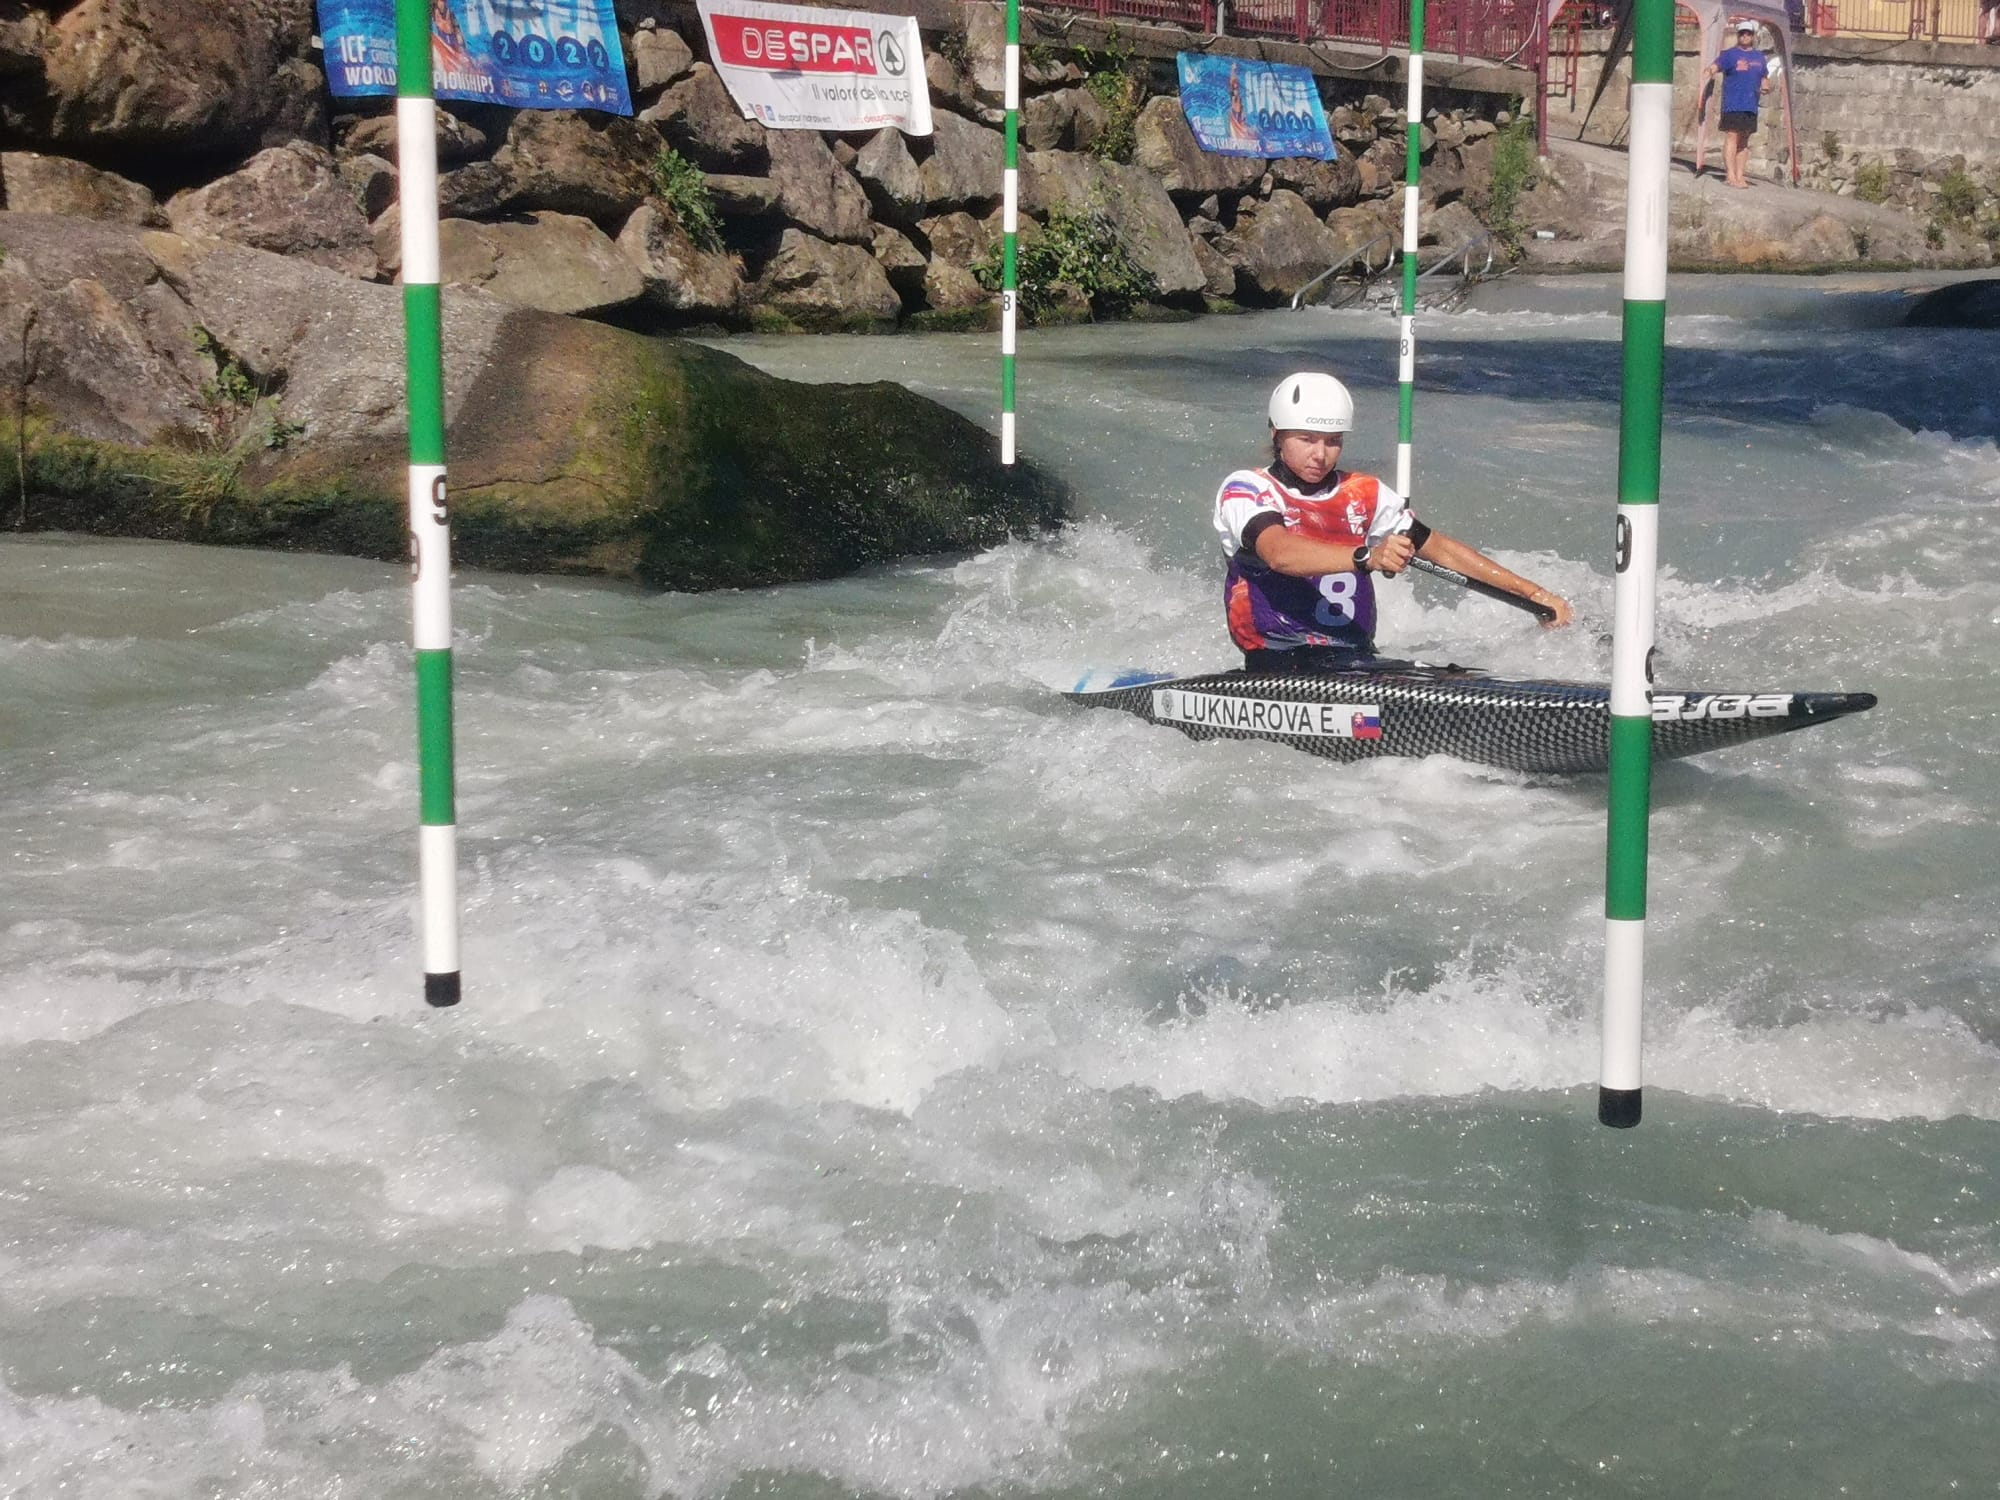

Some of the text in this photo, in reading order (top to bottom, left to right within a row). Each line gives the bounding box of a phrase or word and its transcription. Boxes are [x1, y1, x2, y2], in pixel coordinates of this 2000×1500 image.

[341, 35, 366, 63] ICF
[499, 37, 606, 68] 2022
[741, 27, 875, 66] DESPAR
[345, 66, 397, 86] WORLD
[822, 85, 858, 101] valore
[432, 474, 450, 526] 9
[1615, 513, 1632, 574] 9
[1315, 571, 1357, 627] 8
[1182, 694, 1341, 734] LUKNAROVA E.
